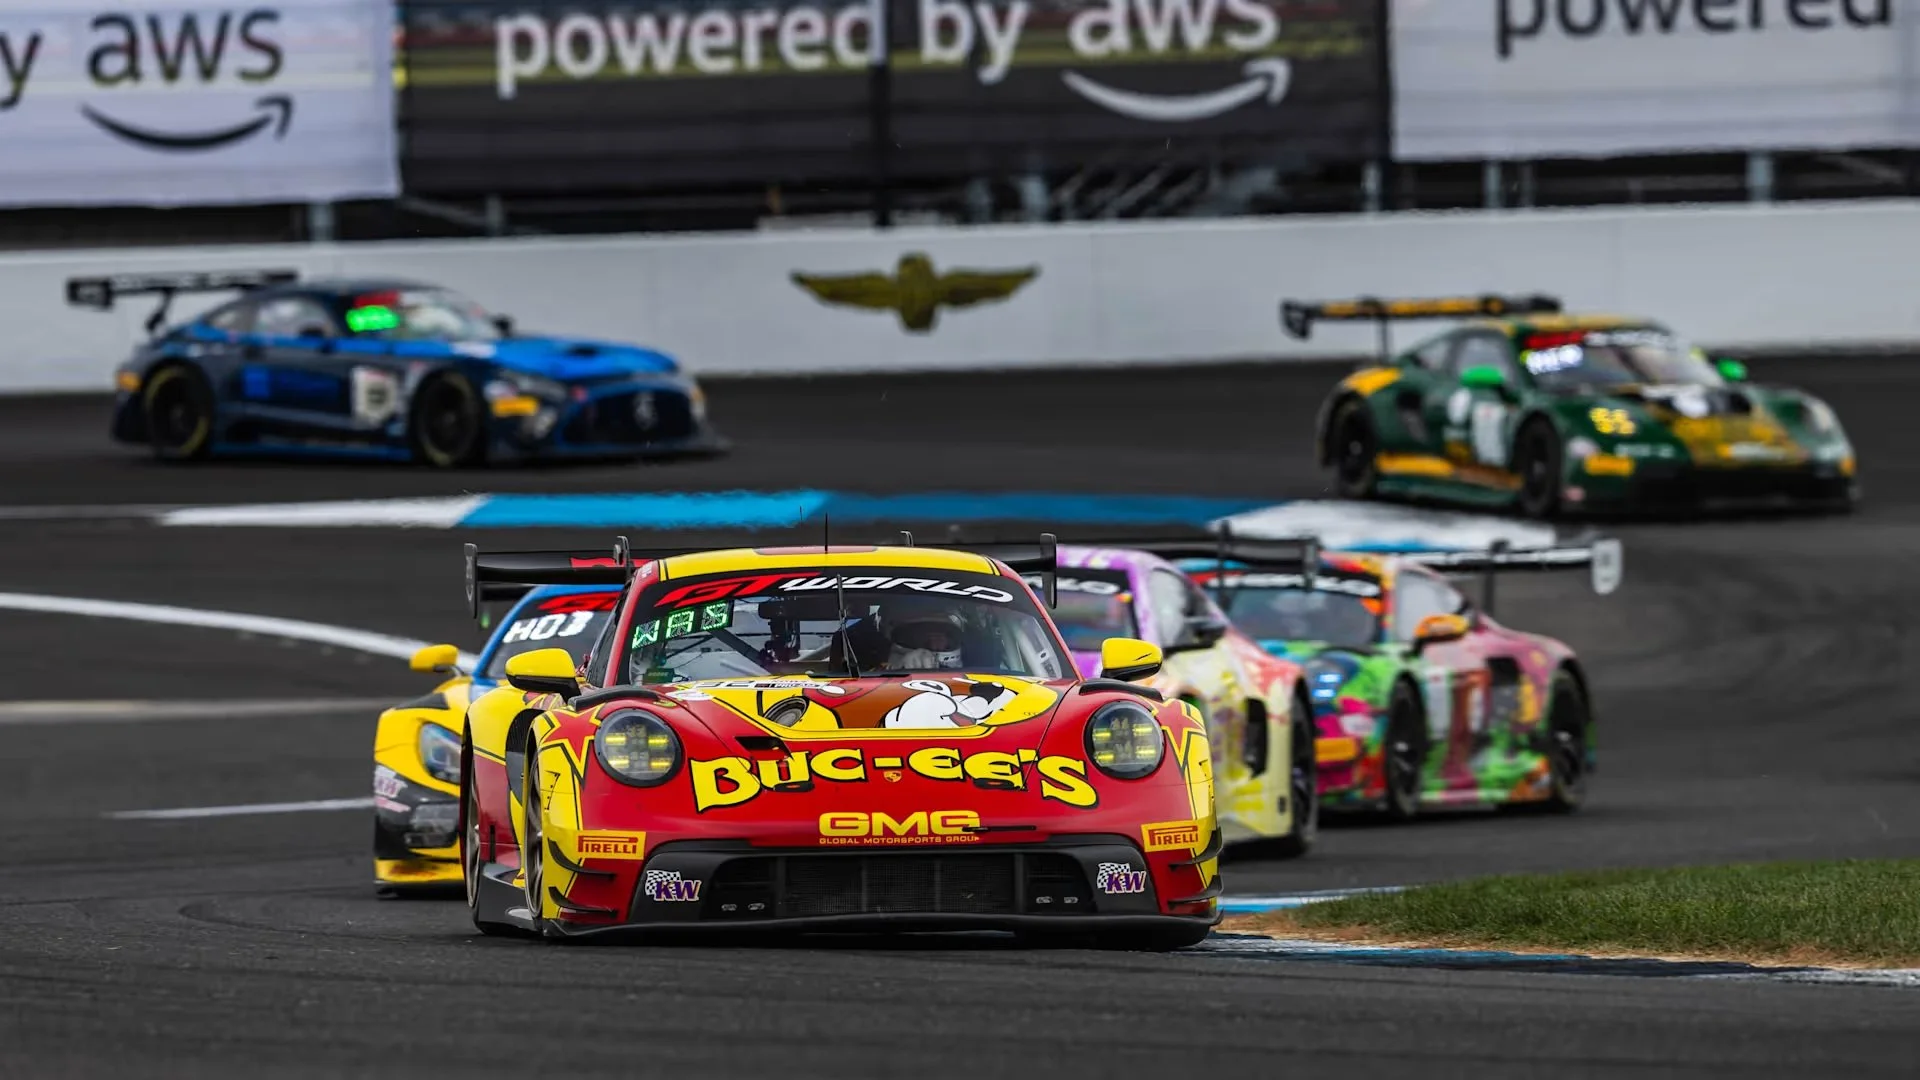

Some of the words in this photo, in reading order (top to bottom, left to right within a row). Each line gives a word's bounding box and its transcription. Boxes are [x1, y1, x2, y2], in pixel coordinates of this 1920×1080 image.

[0, 30, 42, 111] y
[87, 7, 285, 83] aws
[494, 0, 888, 100] powered
[919, 0, 1031, 86] by
[1068, 0, 1281, 58] aws
[654, 571, 822, 607] GT
[779, 576, 1014, 603] WORLD
[631, 602, 729, 649] WAS
[818, 809, 981, 837] GMG
[1147, 825, 1199, 846] PIRELLI
[577, 835, 639, 854] PIRELLI
[819, 836, 860, 845] GLOBAL
[863, 836, 942, 845] MOTORSPORTS
[945, 835, 981, 843] GROUP
[655, 879, 702, 902] KW
[1105, 870, 1147, 894] KW
